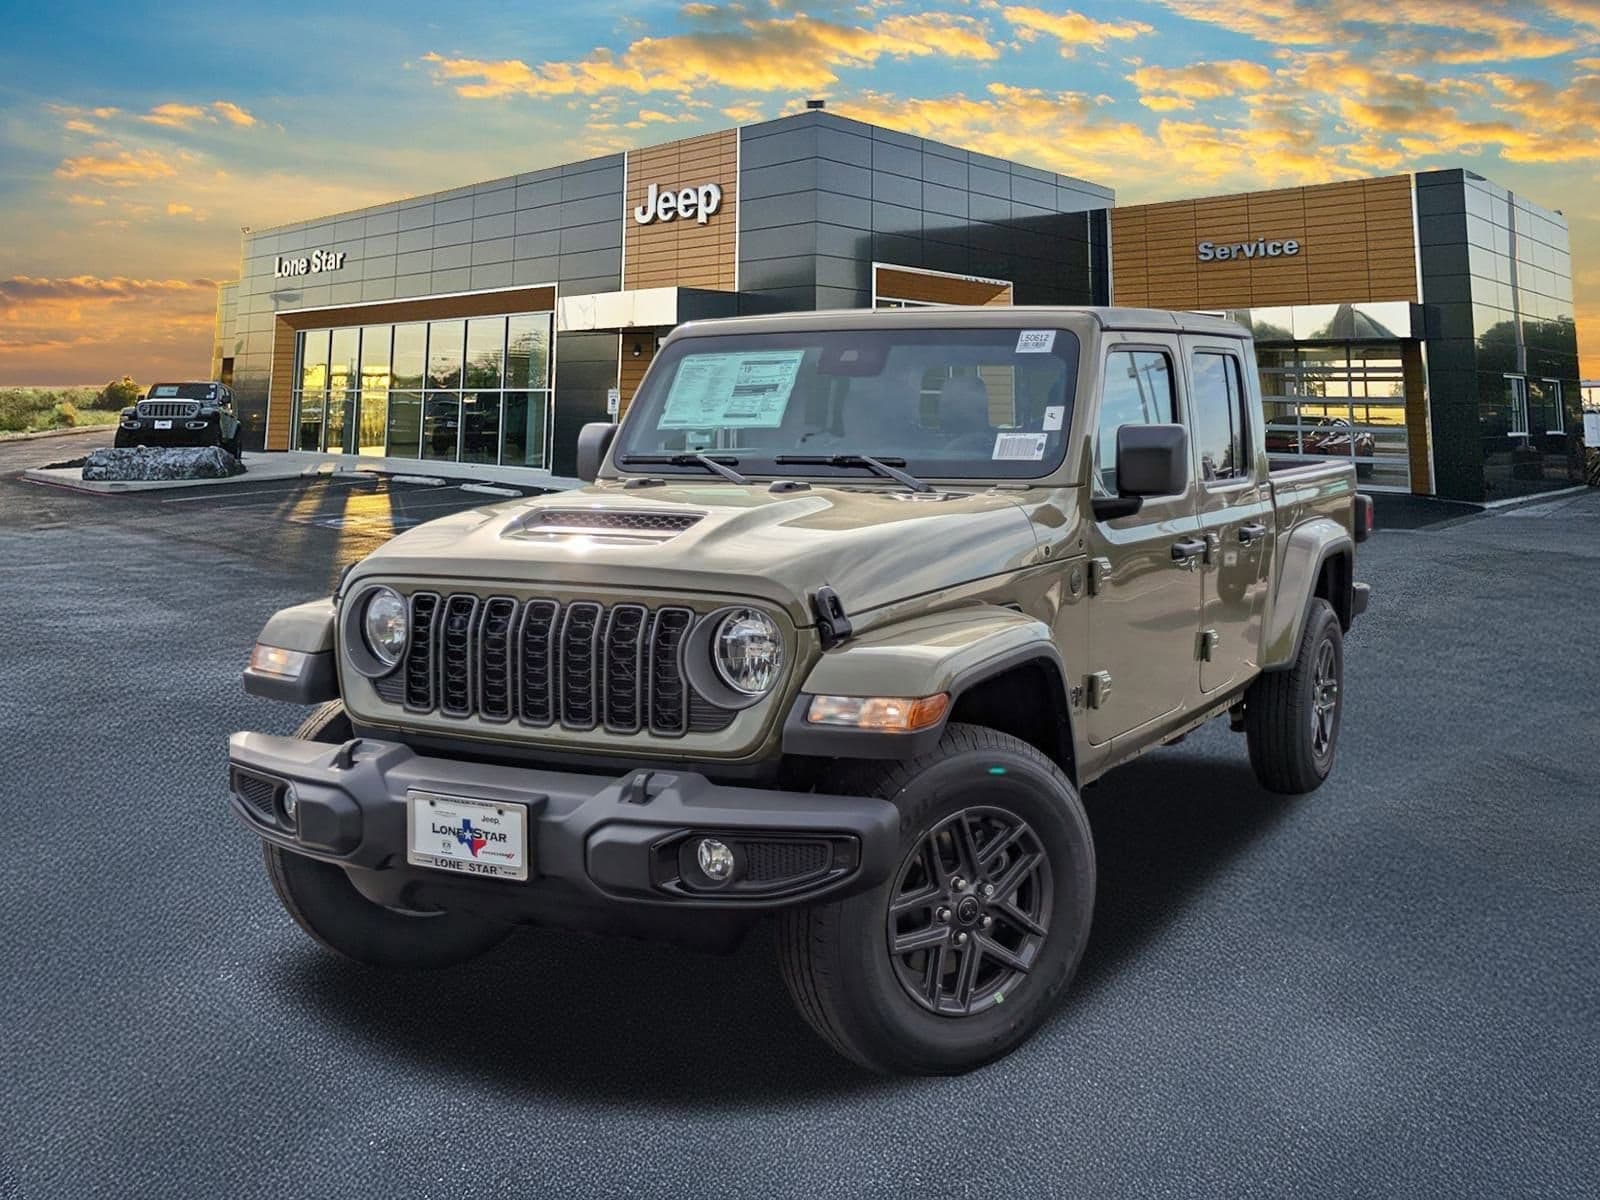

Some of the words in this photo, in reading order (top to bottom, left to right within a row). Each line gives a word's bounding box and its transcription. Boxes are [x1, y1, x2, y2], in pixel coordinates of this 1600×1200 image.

[634, 183, 721, 225] Jeep
[1198, 237, 1299, 261] Service
[275, 256, 309, 278] Lone
[311, 250, 346, 273] Star
[432, 823, 463, 838] LONE
[473, 828, 507, 843] STAR
[434, 858, 463, 869] LONE
[468, 863, 497, 875] STAR
